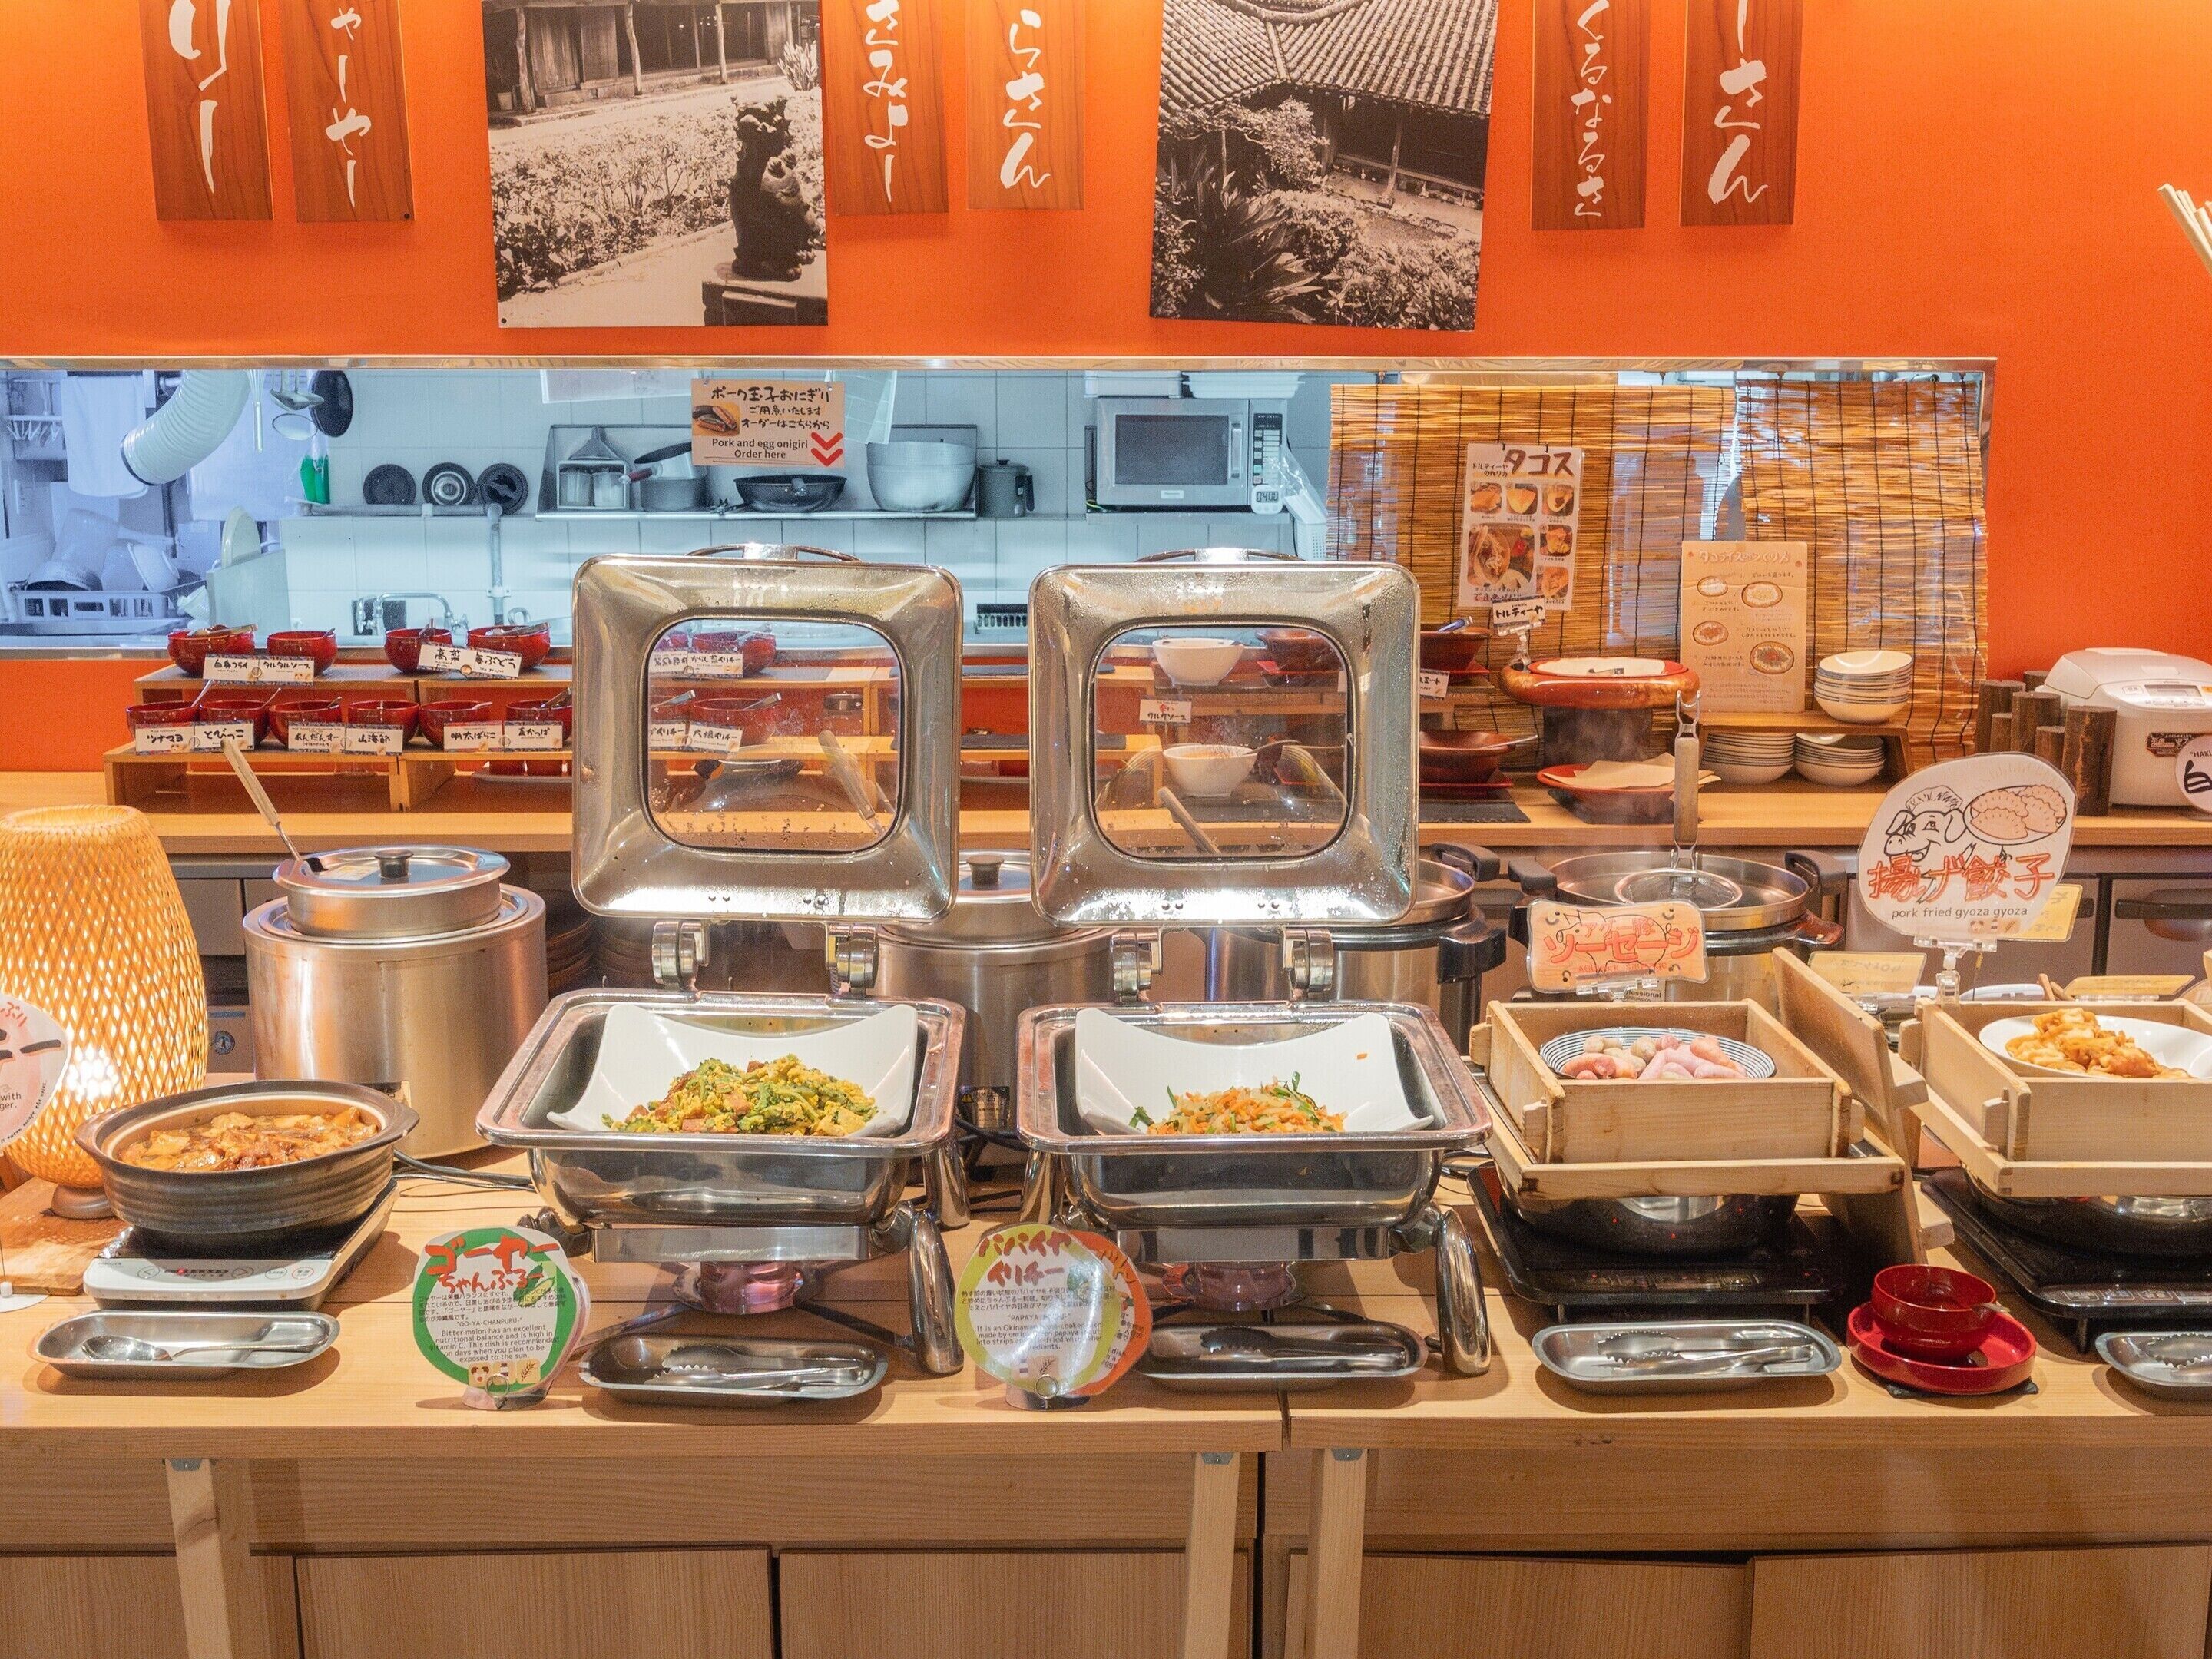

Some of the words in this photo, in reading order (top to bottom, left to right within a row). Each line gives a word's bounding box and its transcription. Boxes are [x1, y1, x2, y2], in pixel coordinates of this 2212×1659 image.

[712, 386, 830, 402] ポーク玉子おにぎり
[750, 405, 820, 416] ご用意いたします
[742, 418, 830, 430] オーダーはこちらから
[712, 439, 734, 447] Pork
[737, 439, 755, 448] and
[758, 442, 774, 450] egg
[777, 439, 808, 451] onigiri
[734, 449, 763, 459] Order
[764, 450, 786, 459] here
[1504, 449, 1574, 476] タコス
[1495, 605, 1543, 618] トルティーヤ
[147, 733, 184, 743] ツナマヨ
[204, 728, 244, 740] とびっこ
[1867, 853, 2055, 904] 揚げ餃子
[1892, 908, 1918, 919] pork
[1923, 907, 1952, 917] fried
[1955, 908, 1989, 919] gyoza
[1994, 907, 2028, 919] gyoza
[1544, 927, 1699, 963] ソーセージ
[978, 1230, 1071, 1258] パパイヤ
[425, 1235, 559, 1276] ゴーヤー
[987, 1260, 1065, 1287] イリチー
[438, 1269, 544, 1295] ちゃんぷるー
[513, 1324, 546, 1333] excellent
[476, 1333, 504, 1342] balance
[528, 1330, 544, 1339] high
[455, 1349, 472, 1357] days
[508, 1346, 524, 1355] plan
